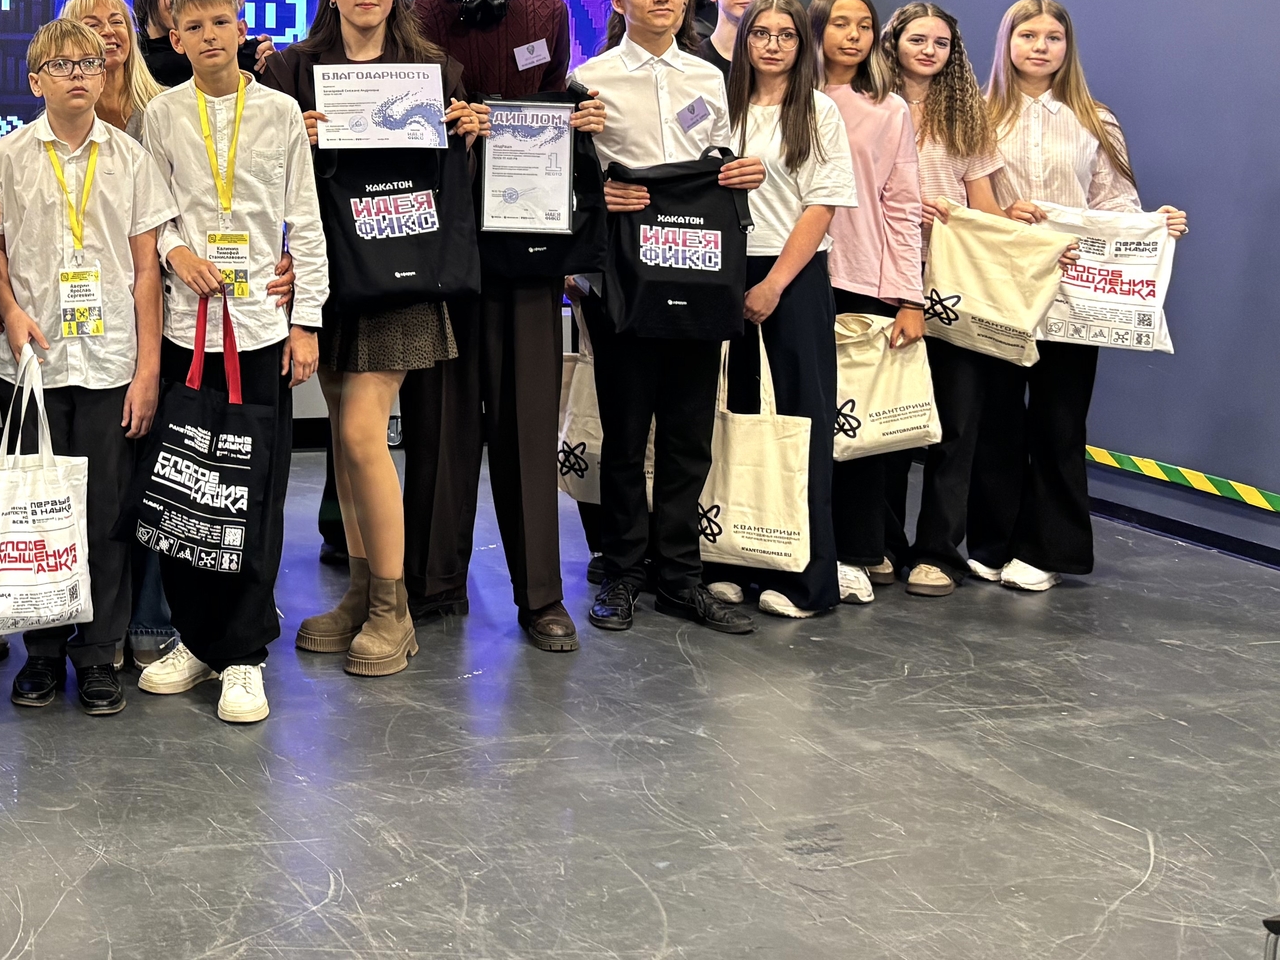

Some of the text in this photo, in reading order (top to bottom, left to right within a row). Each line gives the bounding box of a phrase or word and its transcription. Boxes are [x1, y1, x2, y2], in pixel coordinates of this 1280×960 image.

[322, 71, 430, 81] БЛАГОДАРНОСТЬ
[494, 112, 563, 126] ДИПЛОМ
[545, 152, 562, 171] 1
[365, 180, 413, 192] ХАКАТОН
[350, 190, 434, 219] ИДЕЯ
[355, 211, 439, 239] ФИКС
[657, 214, 704, 225] ХАКАТОН
[640, 225, 721, 250] ИДЕЯ
[640, 246, 721, 271] ФИКС
[1094, 284, 1156, 300] НАУКА
[869, 402, 931, 418] КВАНТОРИУМ
[157, 451, 220, 483] СПОСОБ
[153, 462, 248, 499] МЫШЛЕНИЯ
[190, 488, 247, 513] НАУКА
[733, 524, 801, 536] КВАНТОРИУМ
[36, 554, 77, 574] АУКА
